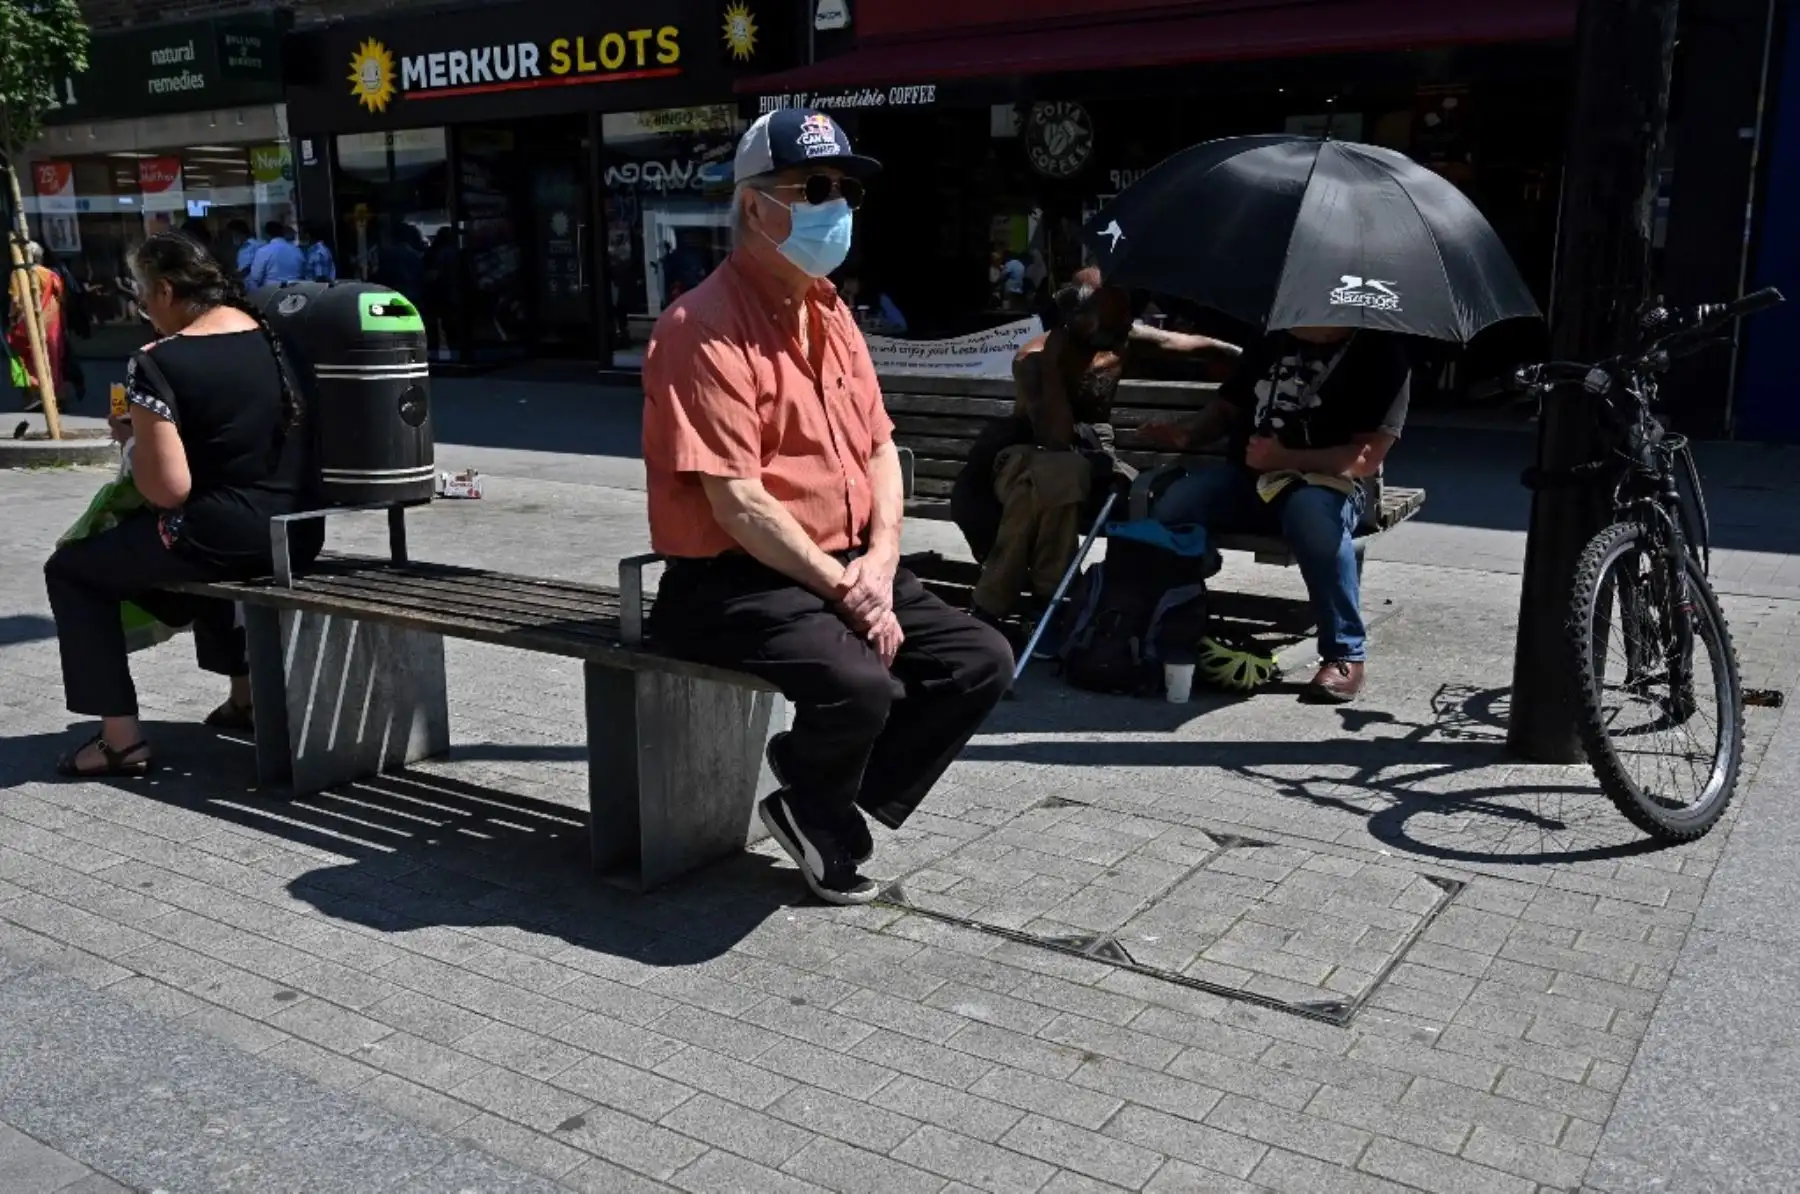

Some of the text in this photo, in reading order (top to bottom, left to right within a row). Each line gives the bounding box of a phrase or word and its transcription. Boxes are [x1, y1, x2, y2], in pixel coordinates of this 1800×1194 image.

[151, 39, 196, 66] natural
[401, 25, 681, 90] MERKUR SLOTS
[148, 68, 205, 94] remedies
[759, 85, 936, 113] HOME OF irresistible COFFEE
[1031, 143, 1087, 175] COFFEE
[1330, 290, 1400, 310] Slazenger
